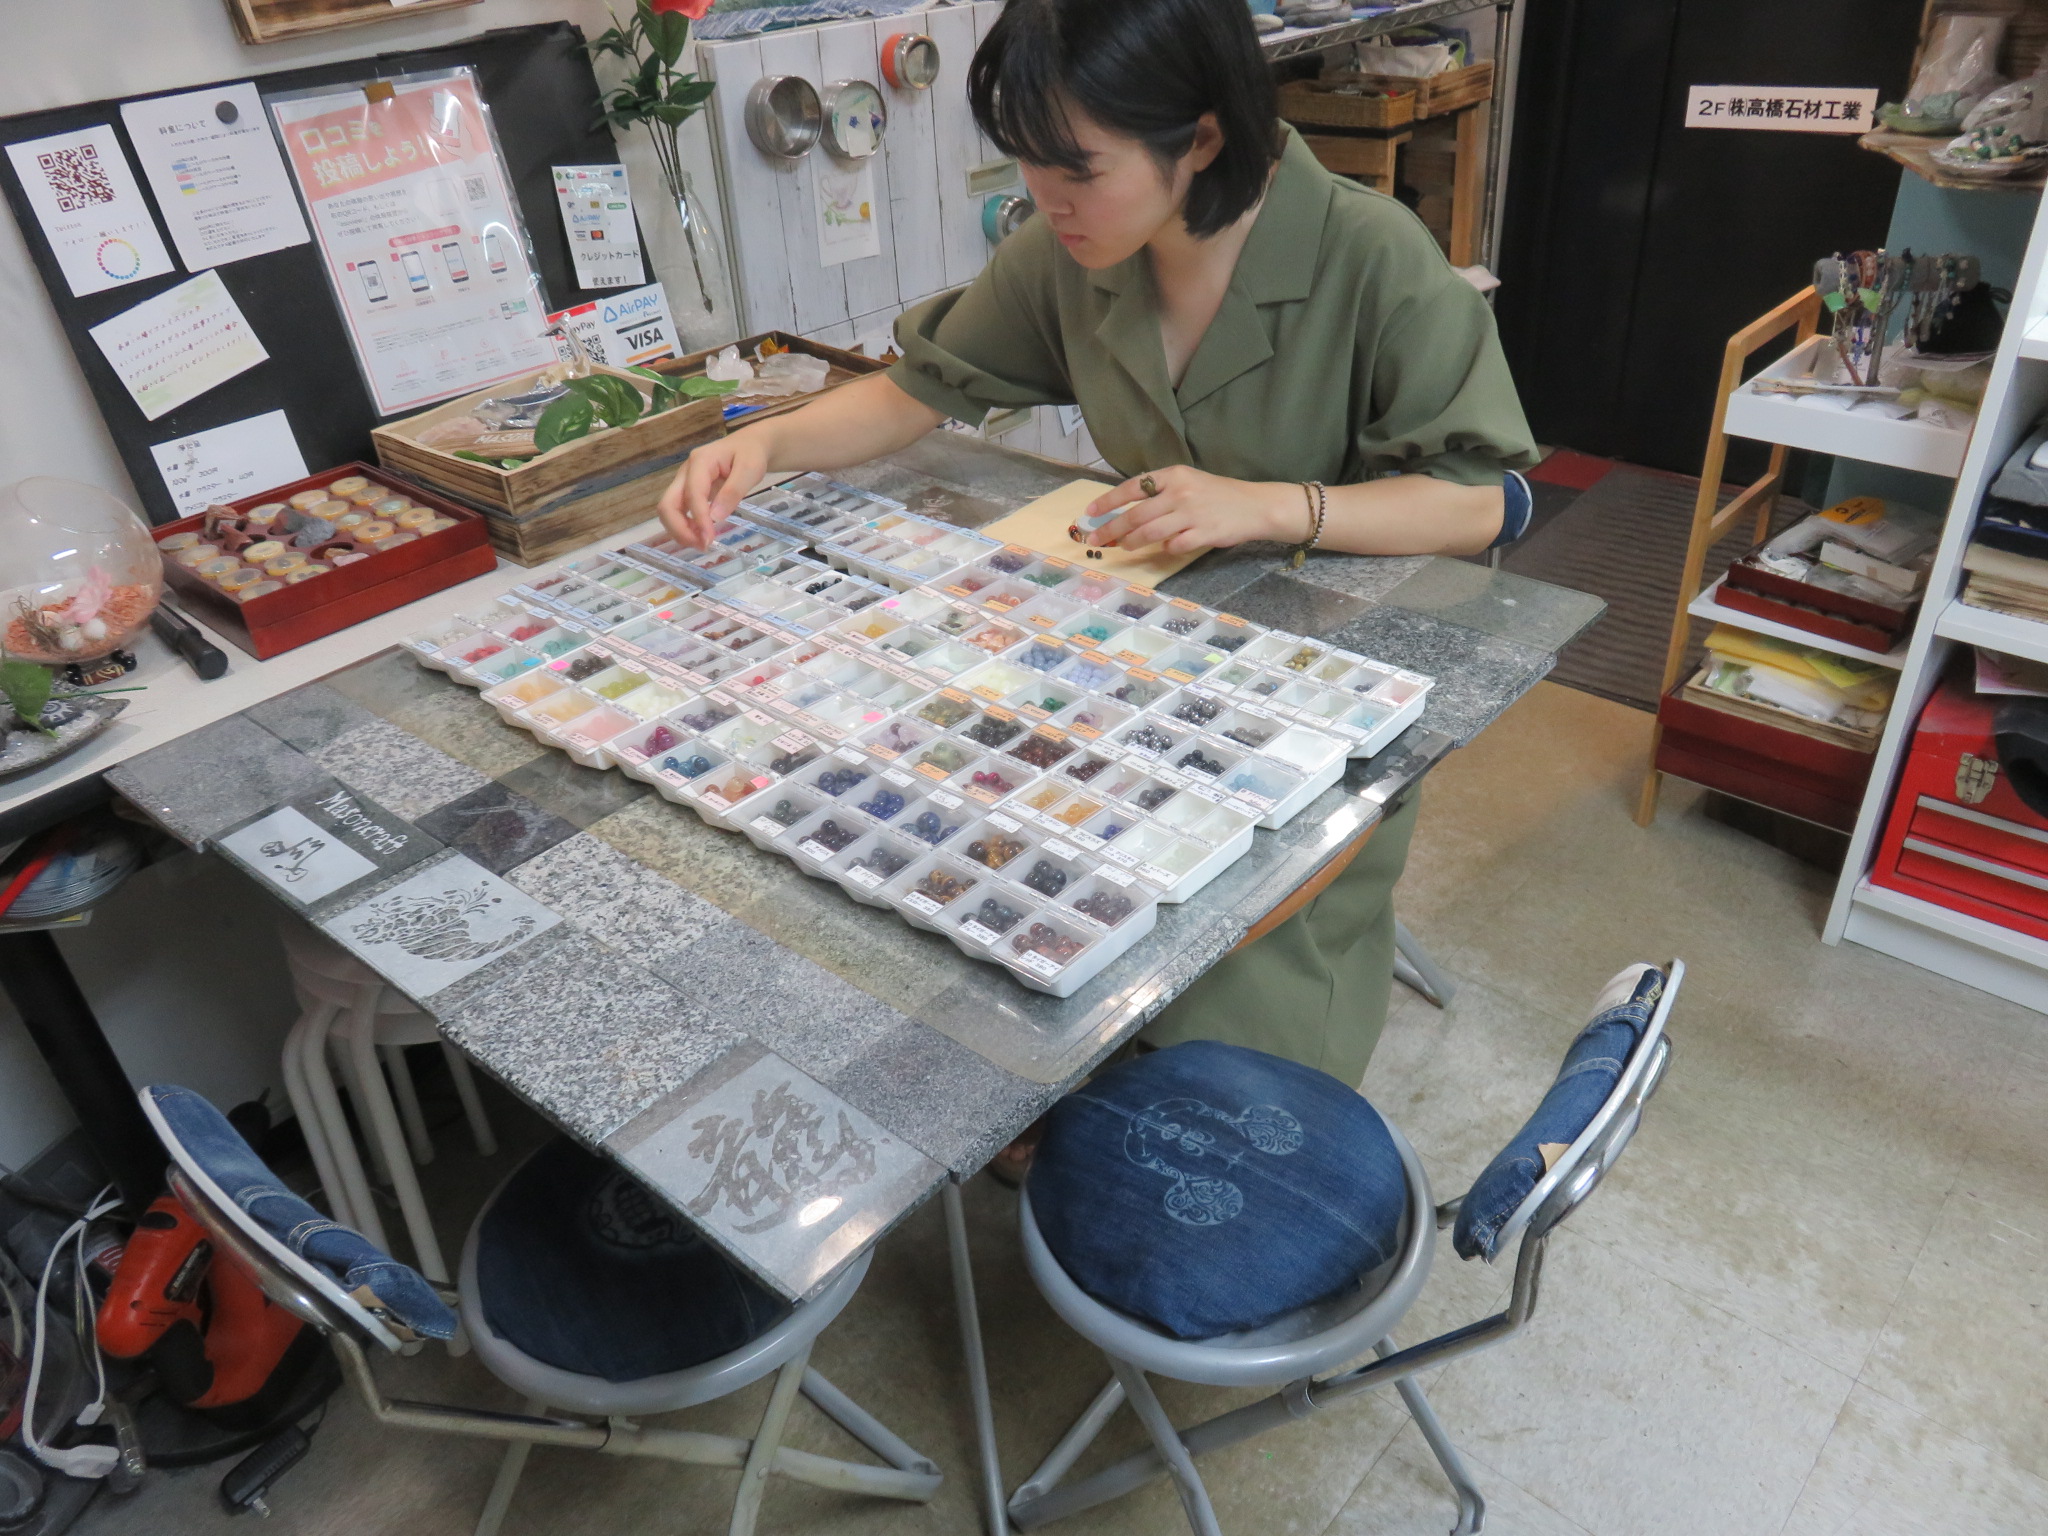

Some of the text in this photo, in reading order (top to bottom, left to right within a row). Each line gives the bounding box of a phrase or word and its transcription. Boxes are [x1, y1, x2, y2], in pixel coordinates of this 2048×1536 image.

[580, 250, 639, 261] クレジットカード
[619, 293, 658, 317] AirPAY
[624, 327, 664, 350] VISA
[315, 790, 408, 854] Masoncraft
